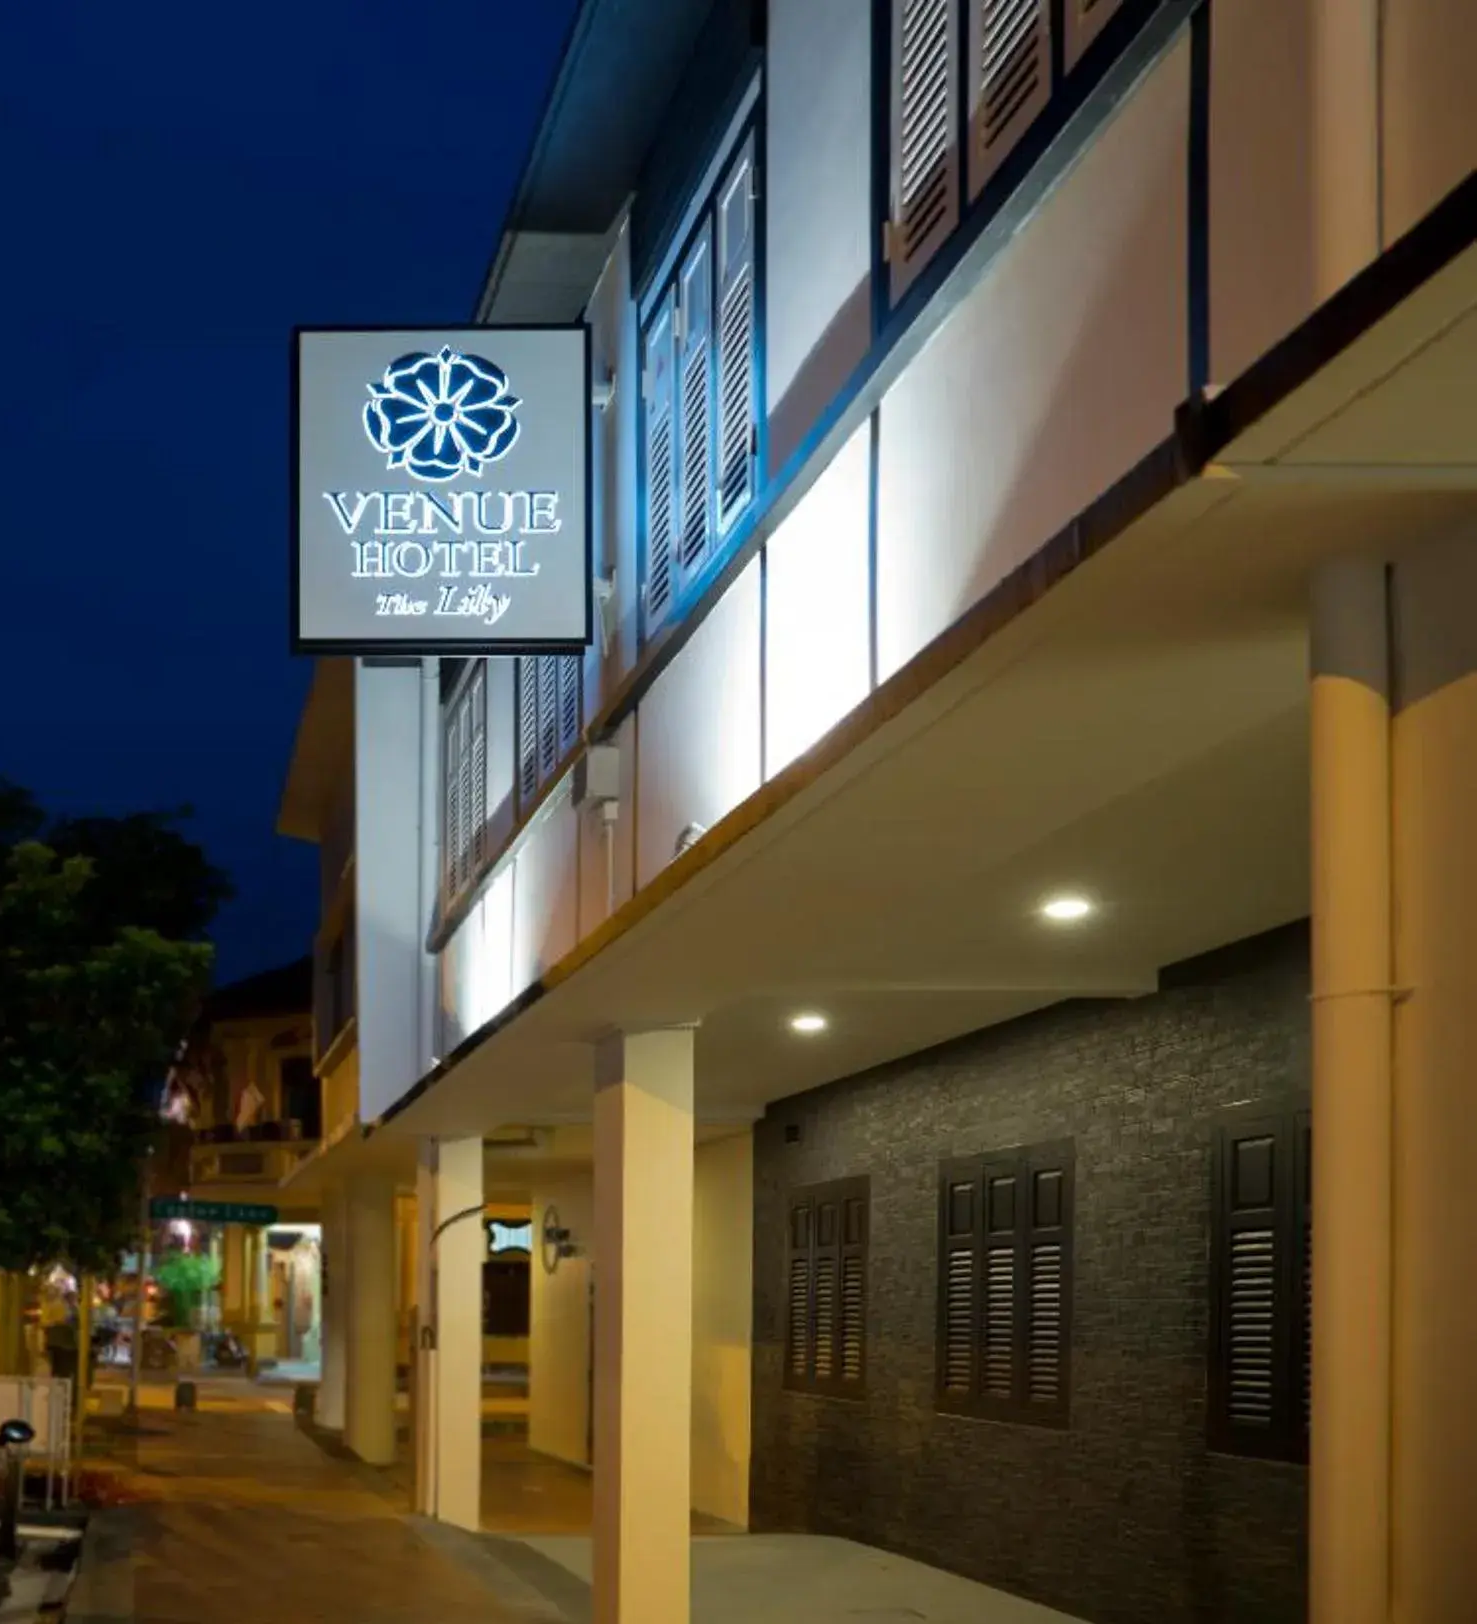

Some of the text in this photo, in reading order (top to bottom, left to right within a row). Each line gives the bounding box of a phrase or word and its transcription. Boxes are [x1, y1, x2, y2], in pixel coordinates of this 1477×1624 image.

[322, 491, 562, 534] VENUE
[350, 540, 541, 577] HOTEL
[375, 582, 511, 625] The Lily
